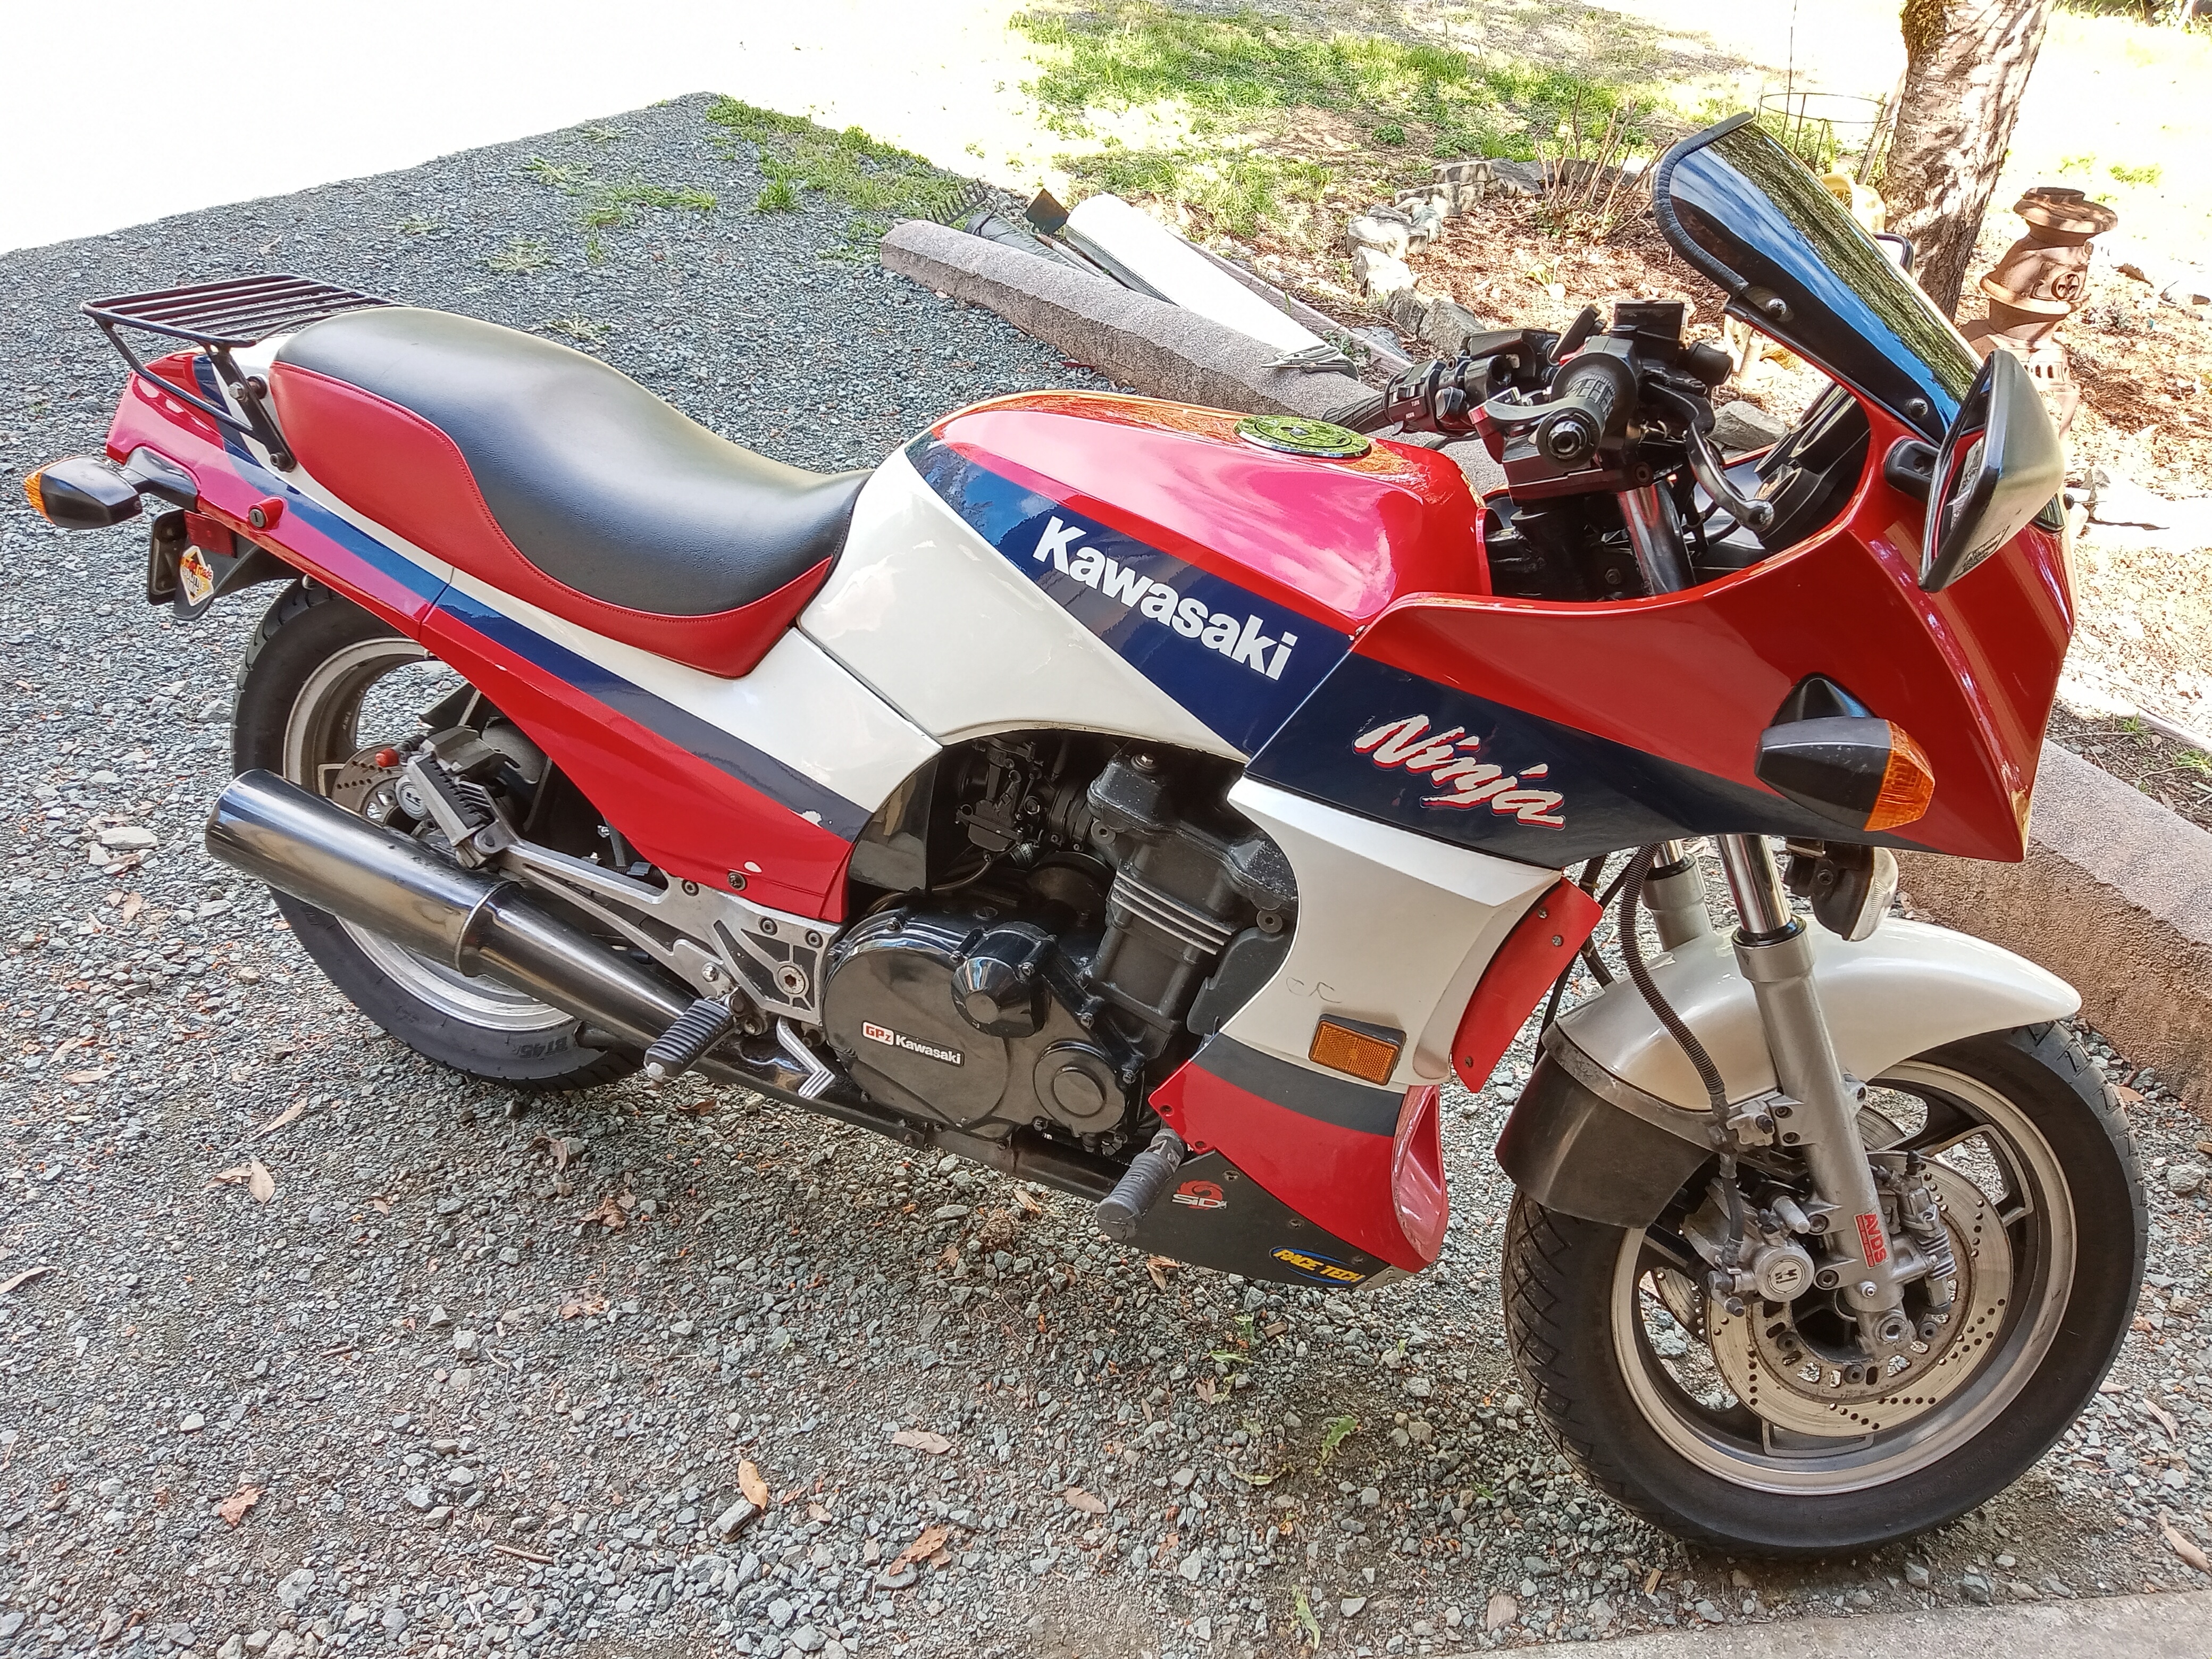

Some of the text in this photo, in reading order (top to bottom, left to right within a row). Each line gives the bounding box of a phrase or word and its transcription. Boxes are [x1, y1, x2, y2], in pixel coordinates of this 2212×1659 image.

[1033, 516, 1298, 681] Kawasaki
[1353, 714, 1565, 830] Ninja
[866, 1025, 961, 1064] GPz Kawasaki
[1863, 1214, 1887, 1263] AVDS
[1273, 1249, 1367, 1283] RACE TECH
